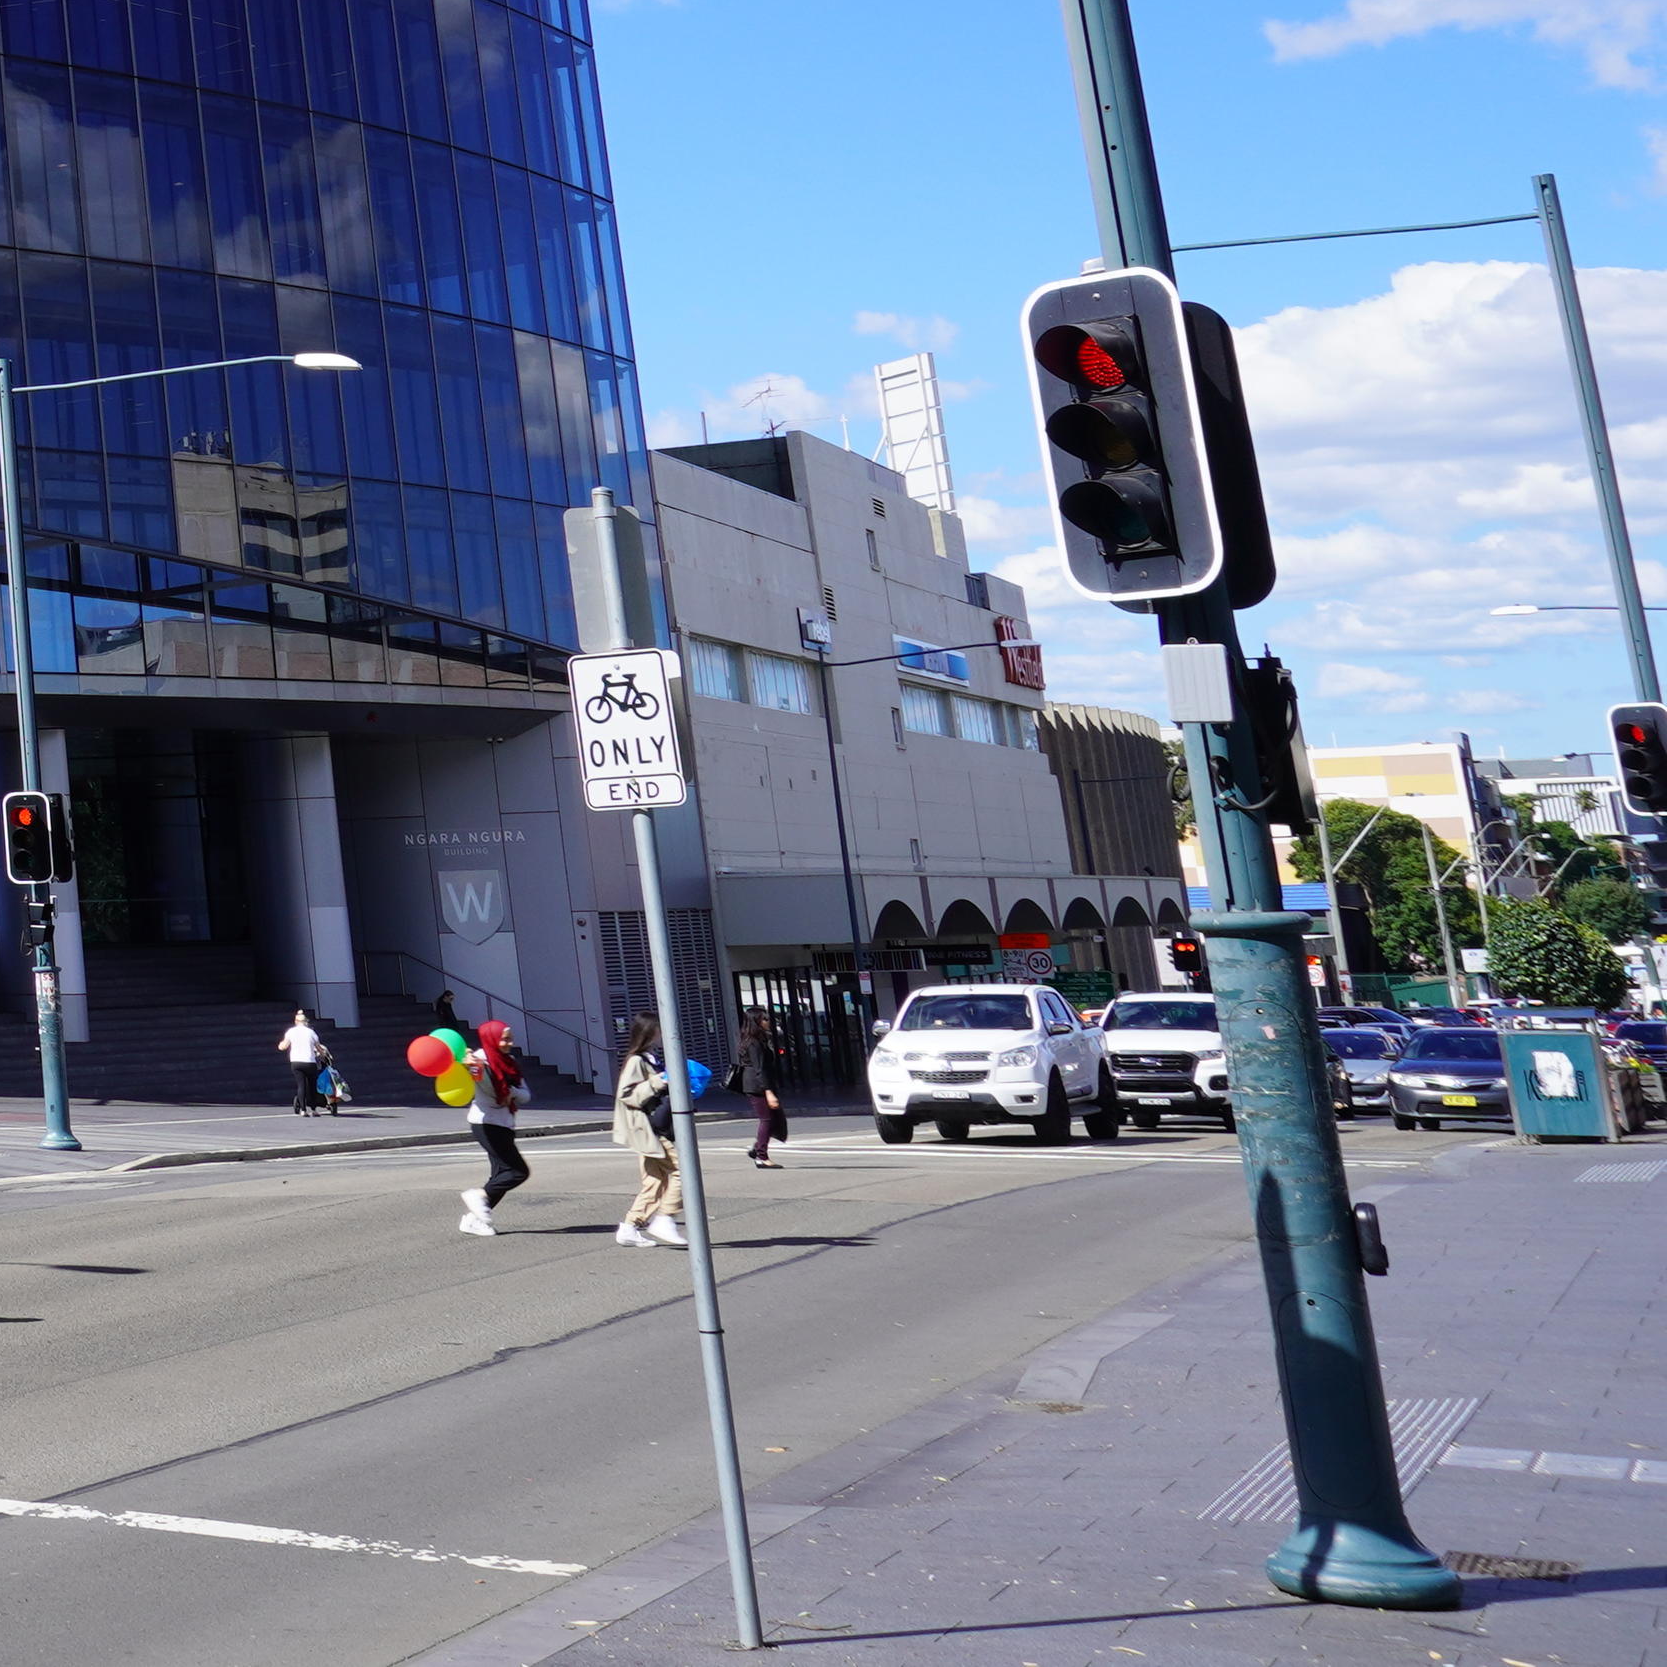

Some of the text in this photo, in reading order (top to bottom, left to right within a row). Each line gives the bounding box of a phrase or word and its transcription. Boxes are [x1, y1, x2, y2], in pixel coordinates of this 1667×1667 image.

[590, 736, 665, 767] ONLY
[609, 781, 659, 801] END
[405, 831, 526, 845] NGARA NGURA
[1031, 957, 1048, 969] 30
